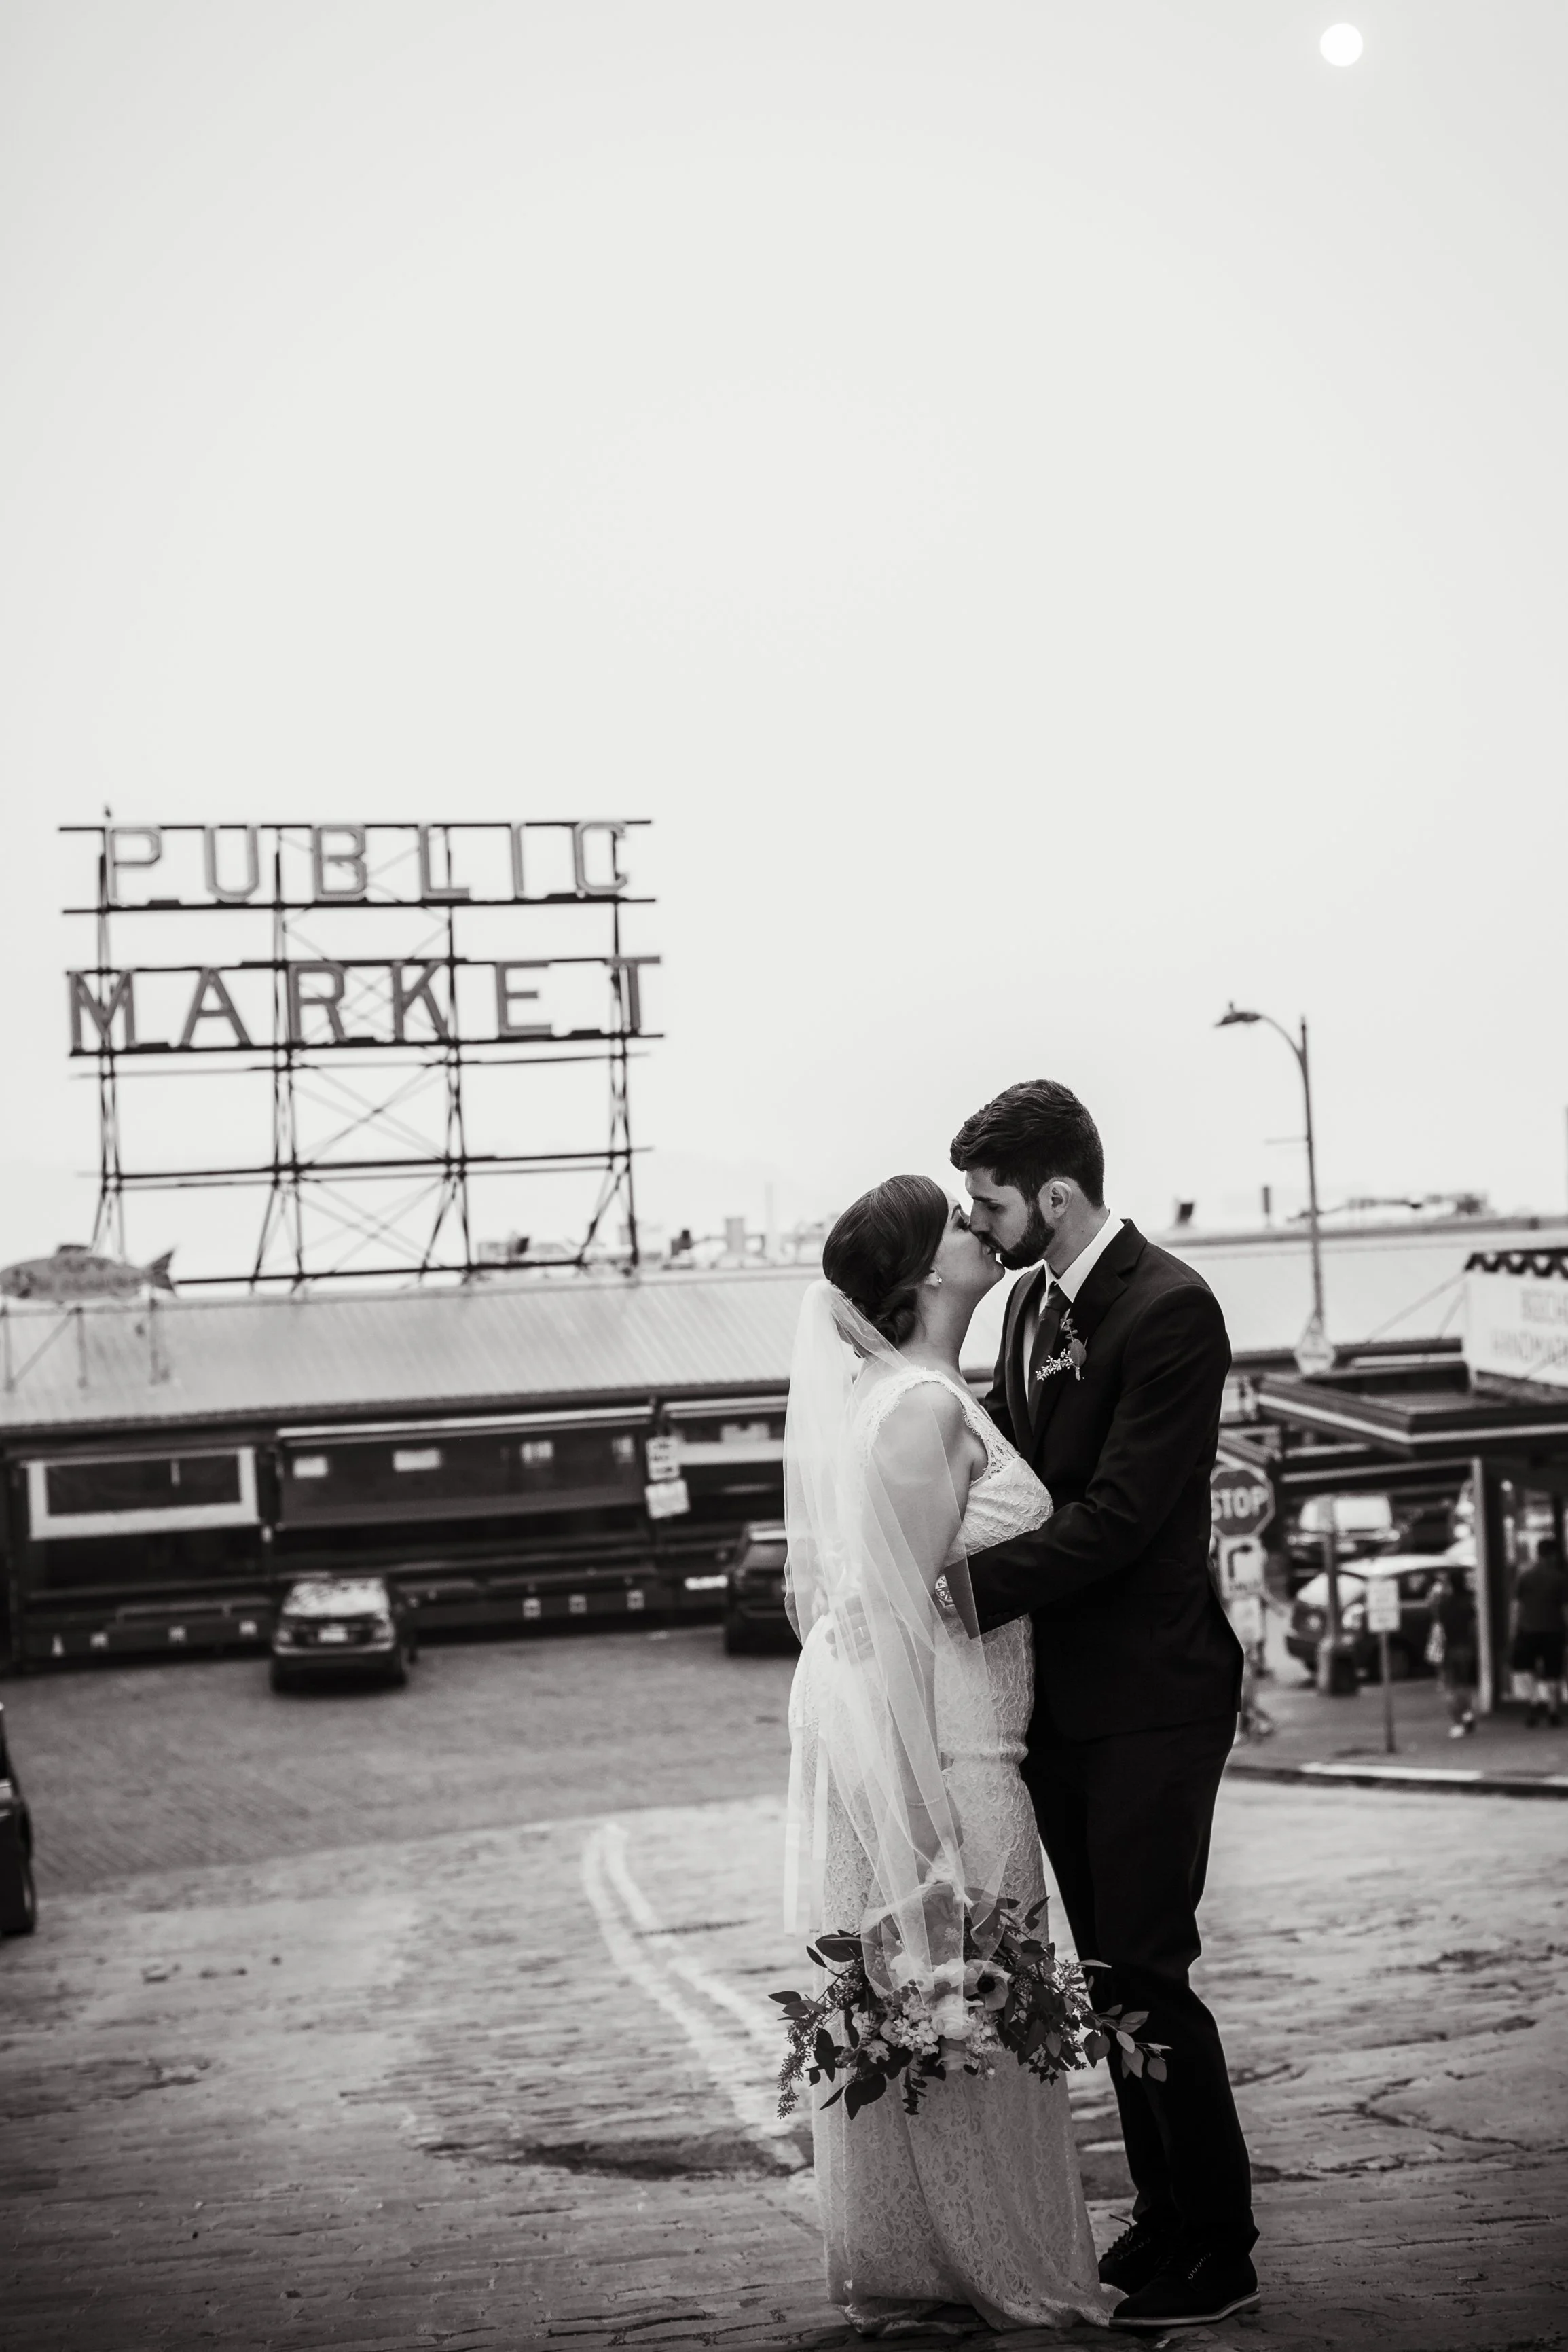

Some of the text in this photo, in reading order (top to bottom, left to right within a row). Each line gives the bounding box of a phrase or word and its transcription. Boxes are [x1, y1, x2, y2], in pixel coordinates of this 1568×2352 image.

[105, 822, 627, 904] PUBLIC
[71, 957, 660, 1050] MARKET
[1211, 1486, 1269, 1521] STOP
